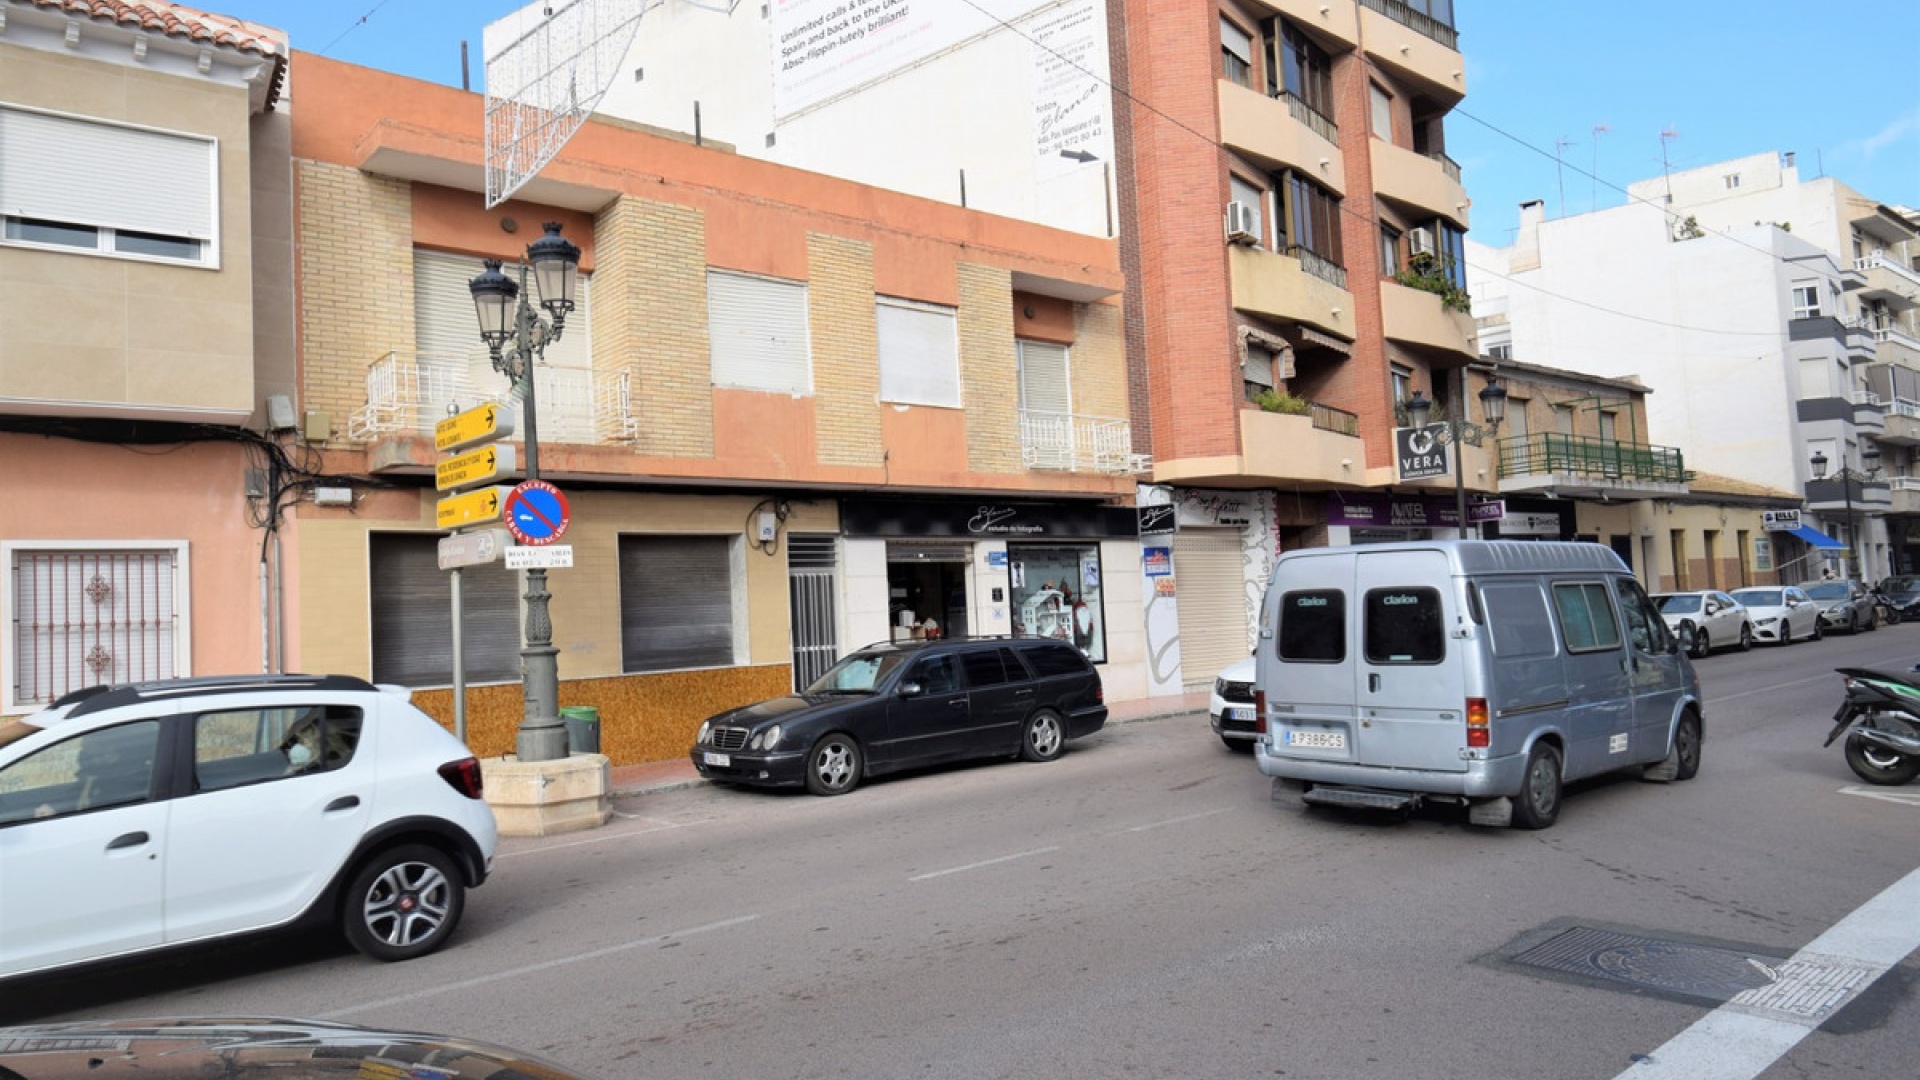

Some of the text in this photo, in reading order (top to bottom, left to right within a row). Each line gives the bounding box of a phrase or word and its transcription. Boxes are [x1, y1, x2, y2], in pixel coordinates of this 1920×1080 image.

[780, 15, 824, 43] Unlimited
[825, 6, 847, 22] calls
[849, 1, 857, 12] &
[781, 40, 806, 58] Spain
[807, 30, 825, 45] and
[827, 20, 849, 37] back
[851, 13, 862, 24] to
[863, 4, 881, 20] the
[782, 27, 866, 71] Abso-flippin-lutely
[868, 5, 910, 32] brilliant!
[1402, 454, 1443, 470] VERA
[516, 481, 558, 494] EXCEPTO
[506, 510, 523, 539] CARGA
[533, 518, 569, 545] DESCARGA
